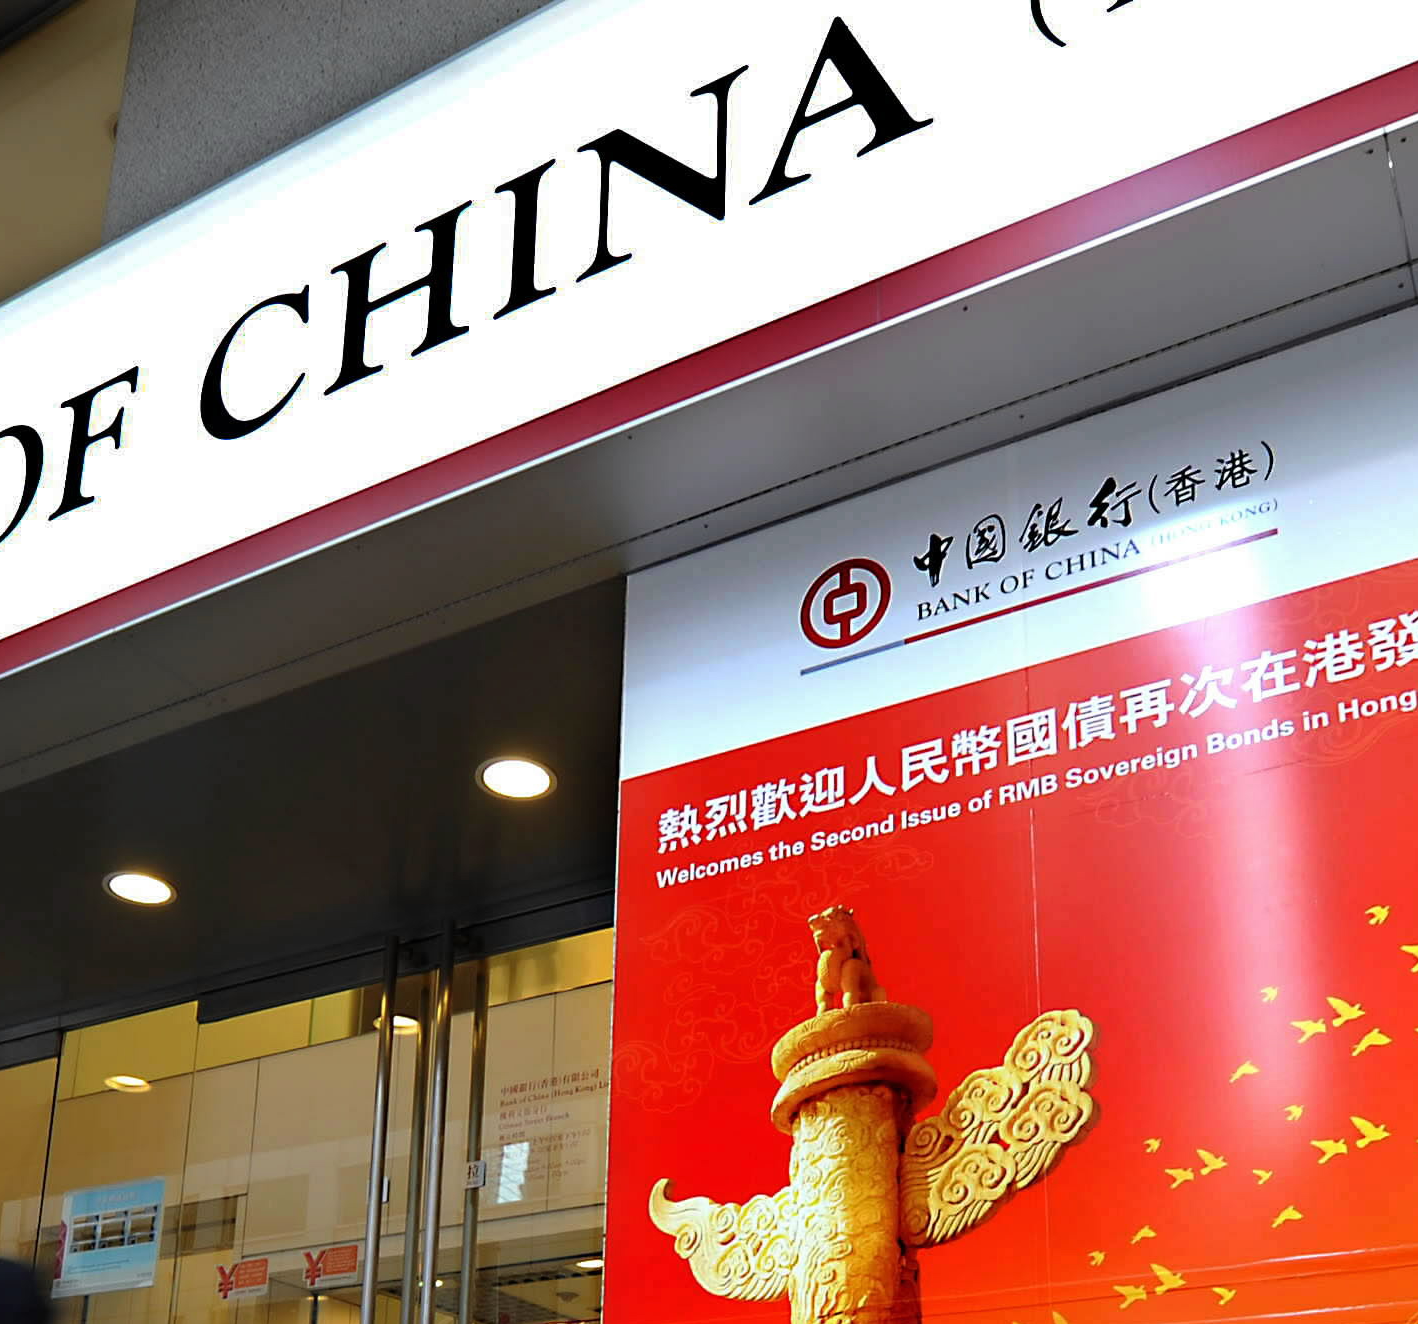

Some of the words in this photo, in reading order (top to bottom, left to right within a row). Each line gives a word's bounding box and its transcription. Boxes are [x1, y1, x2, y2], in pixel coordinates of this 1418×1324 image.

[201, 17, 933, 440] CHINA
[917, 582, 990, 621] BANK
[1000, 567, 1035, 595] OF
[1044, 537, 1141, 581] CHINA
[1218, 497, 1279, 531] KONG)
[656, 850, 764, 889] Welcomes
[769, 839, 805, 862] the
[810, 813, 894, 852] Second
[901, 802, 961, 830] Issue
[967, 786, 992, 811] of
[998, 776, 1059, 807] RMB
[1065, 742, 1199, 789] Sovereign
[1206, 718, 1295, 755] Bonds
[1303, 710, 1329, 732] in
[1338, 688, 1418, 723] Hong
